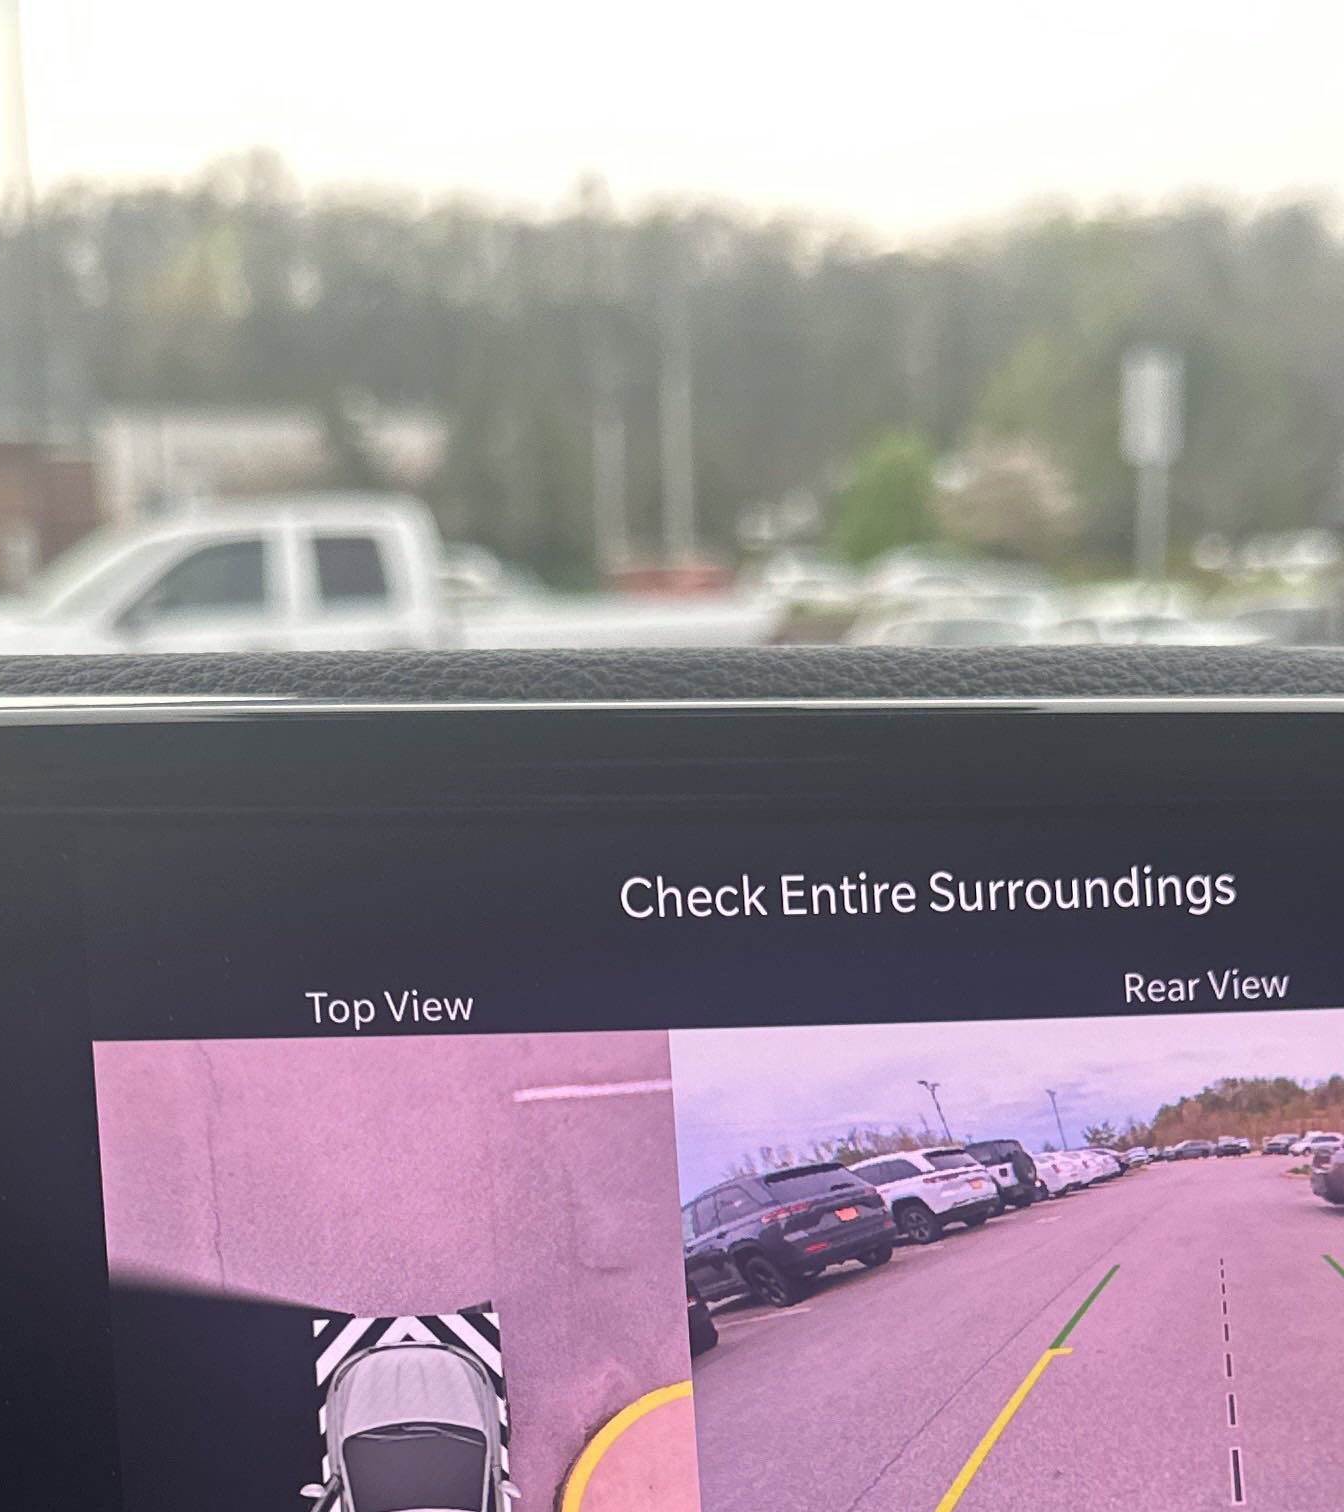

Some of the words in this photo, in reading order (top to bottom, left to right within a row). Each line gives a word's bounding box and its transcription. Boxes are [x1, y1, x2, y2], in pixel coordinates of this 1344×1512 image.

[620, 874, 768, 919] Check
[780, 871, 916, 916] Entire
[929, 865, 1236, 916] Surroundings
[1124, 973, 1200, 1003] Rear
[1207, 968, 1289, 1000] View
[304, 992, 375, 1031] Top
[383, 989, 474, 1022] View
